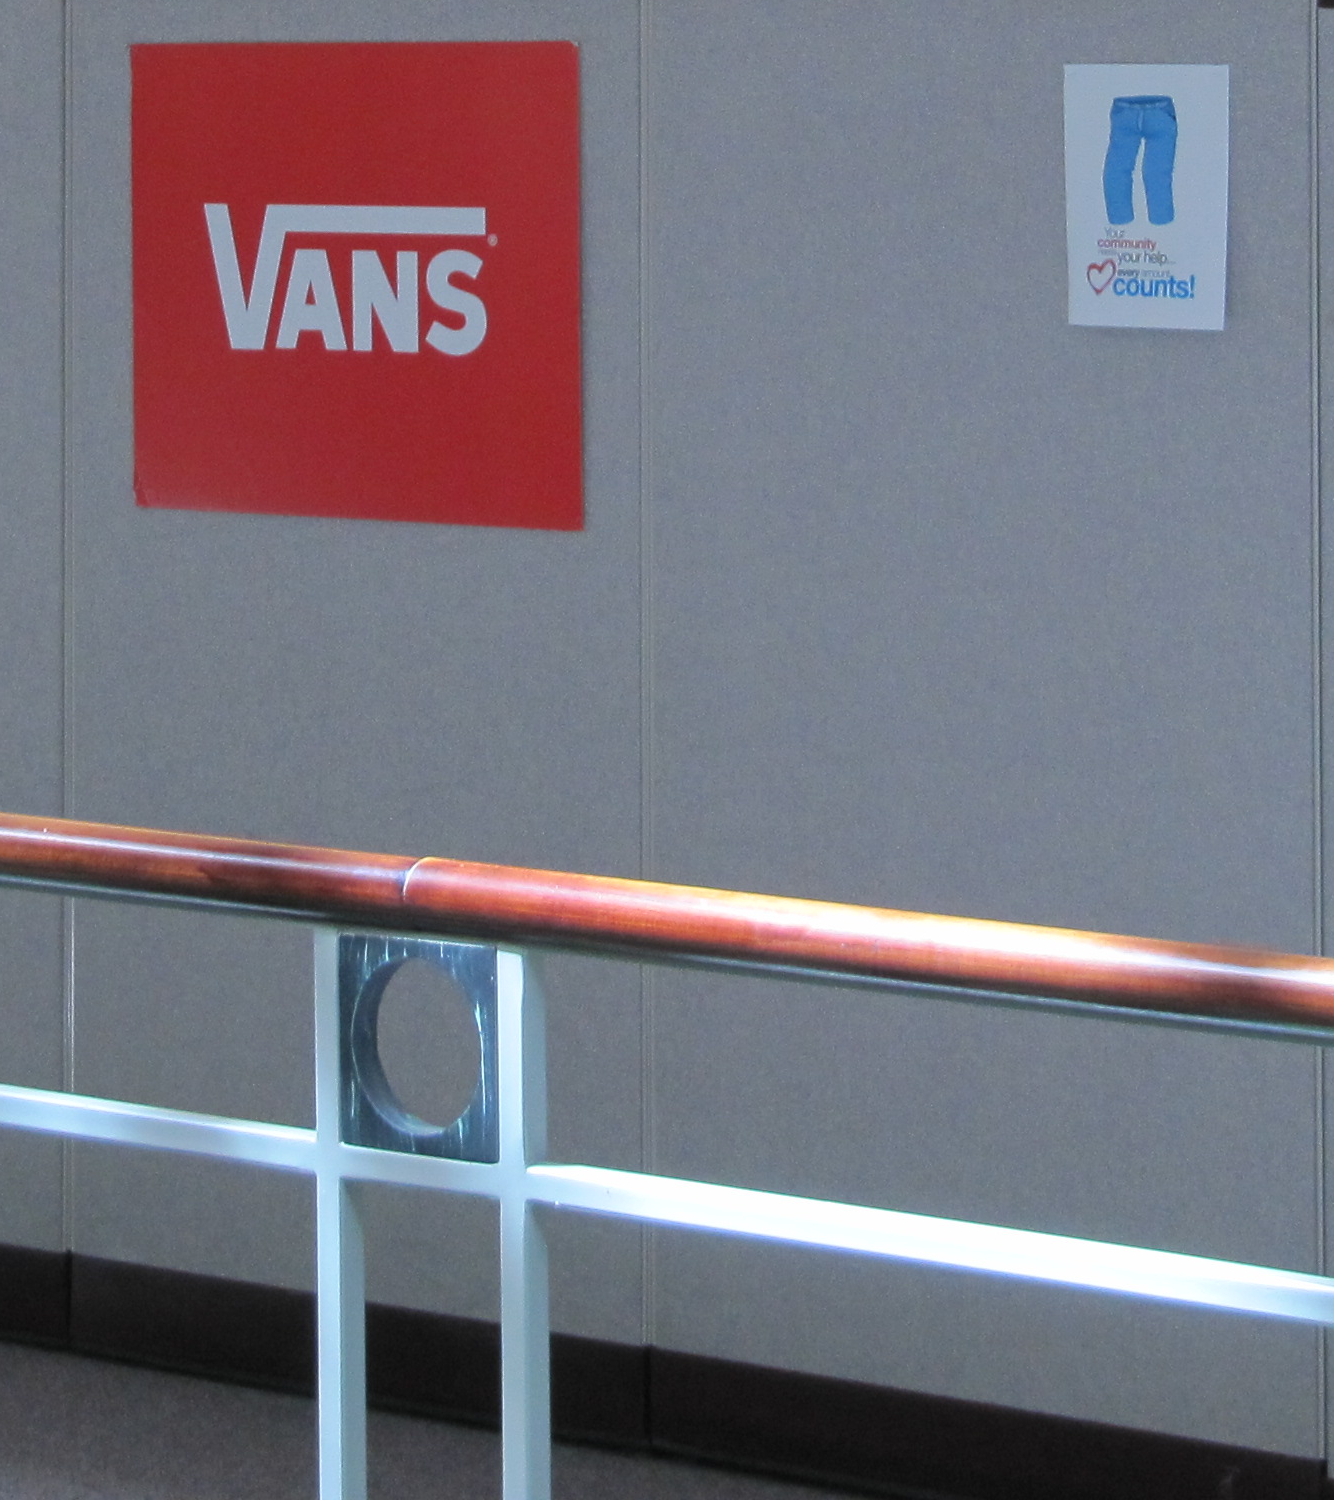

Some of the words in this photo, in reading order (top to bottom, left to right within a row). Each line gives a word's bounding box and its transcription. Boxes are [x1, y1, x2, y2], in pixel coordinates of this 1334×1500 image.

[1097, 237, 1158, 252] community
[1117, 251, 1140, 266] your
[204, 202, 488, 356] VANS
[1113, 274, 1196, 300] counts!
